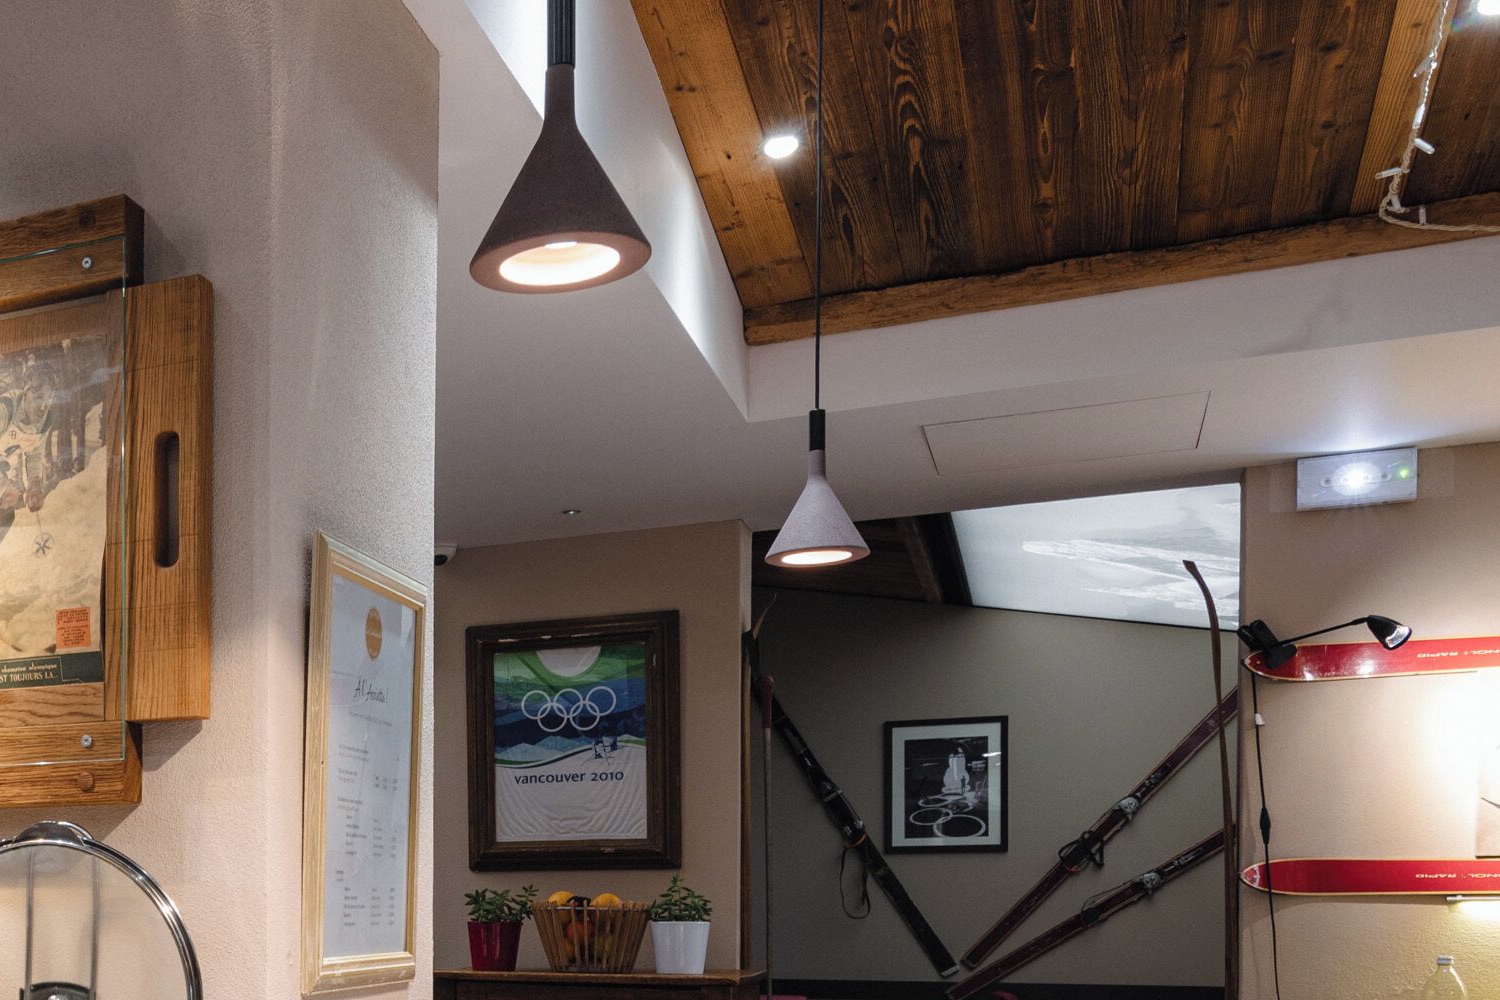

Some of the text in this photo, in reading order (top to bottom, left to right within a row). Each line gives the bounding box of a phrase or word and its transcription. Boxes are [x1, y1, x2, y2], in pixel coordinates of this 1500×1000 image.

[10, 672, 43, 682] TOUJOURS
[514, 771, 624, 785] vancouver 2010
